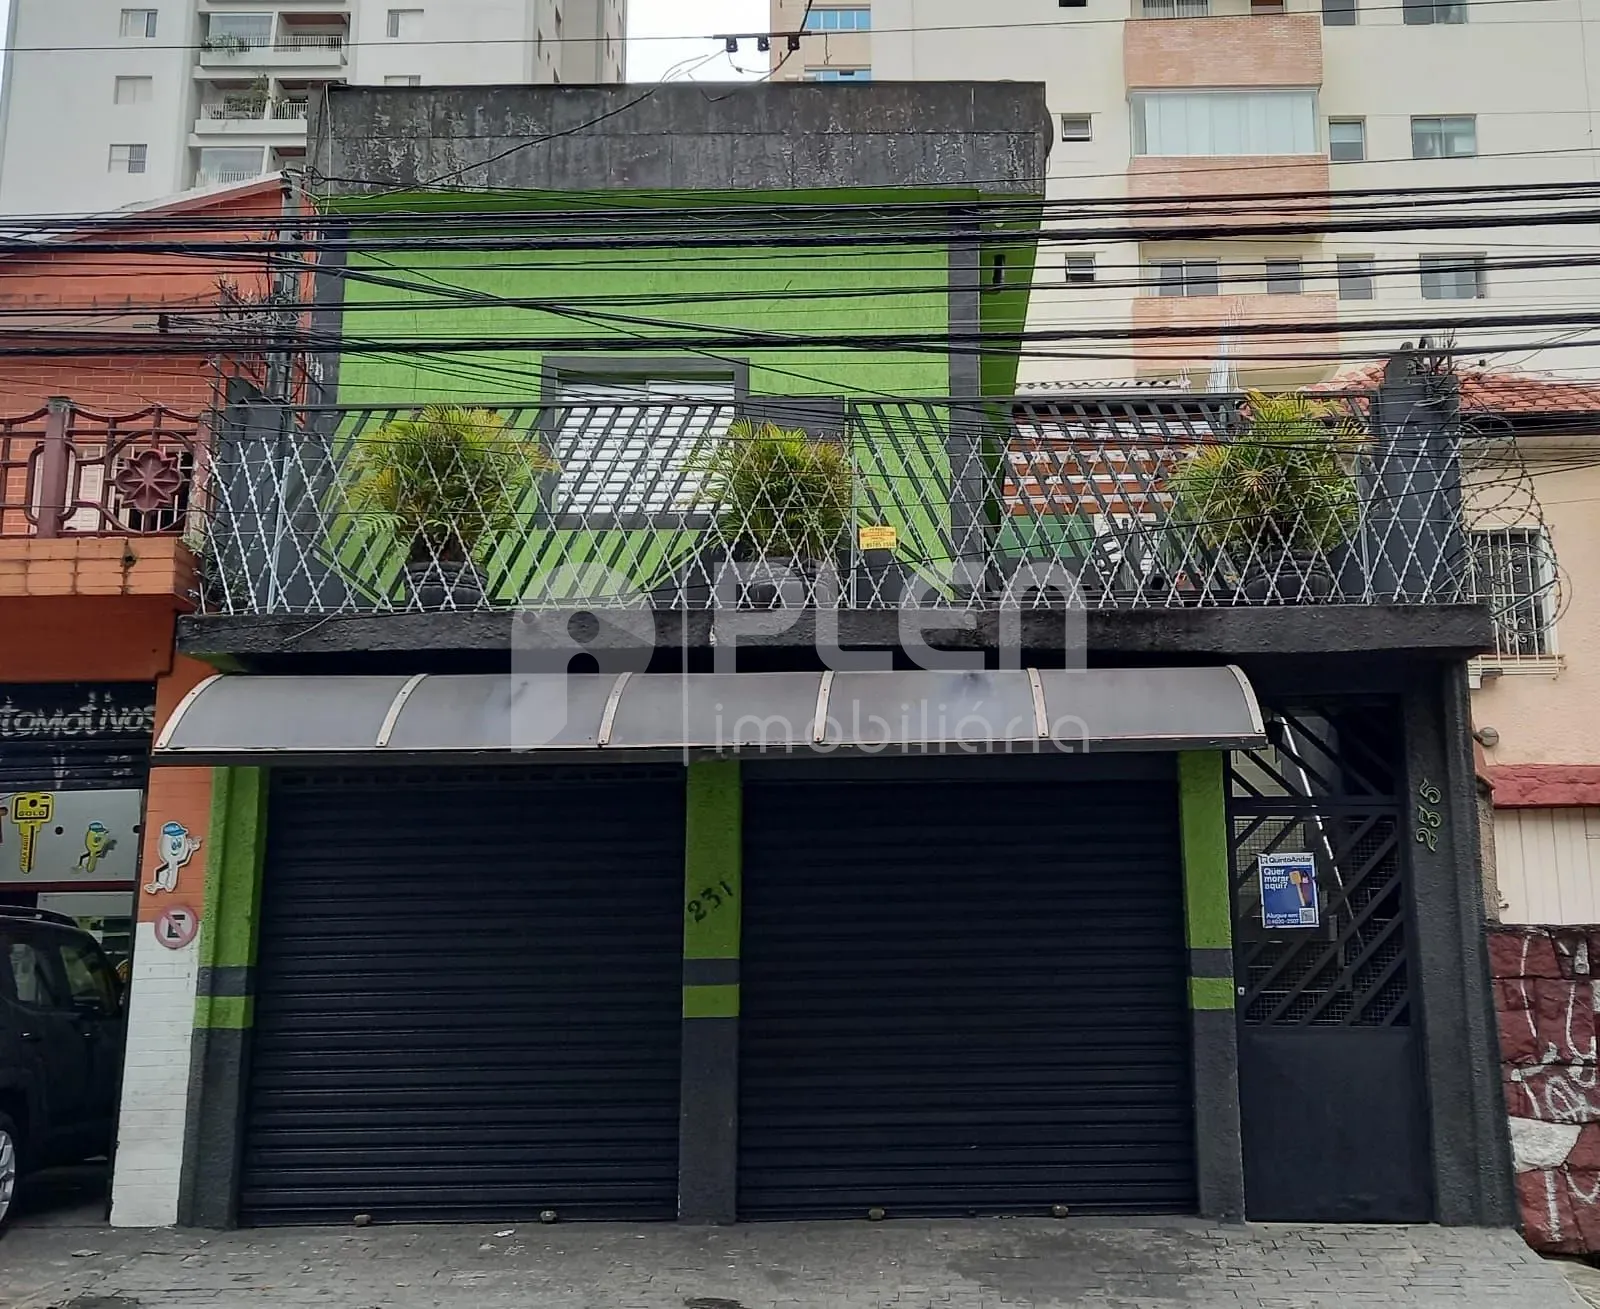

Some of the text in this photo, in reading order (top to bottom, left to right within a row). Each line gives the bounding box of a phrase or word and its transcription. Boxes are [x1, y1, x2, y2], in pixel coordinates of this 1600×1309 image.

[1416, 777, 1442, 852] 235
[1268, 856, 1311, 864] QuintoAndar
[1264, 868, 1284, 876] Quer
[1264, 882, 1288, 891] aqui?
[688, 881, 733, 923] 231
